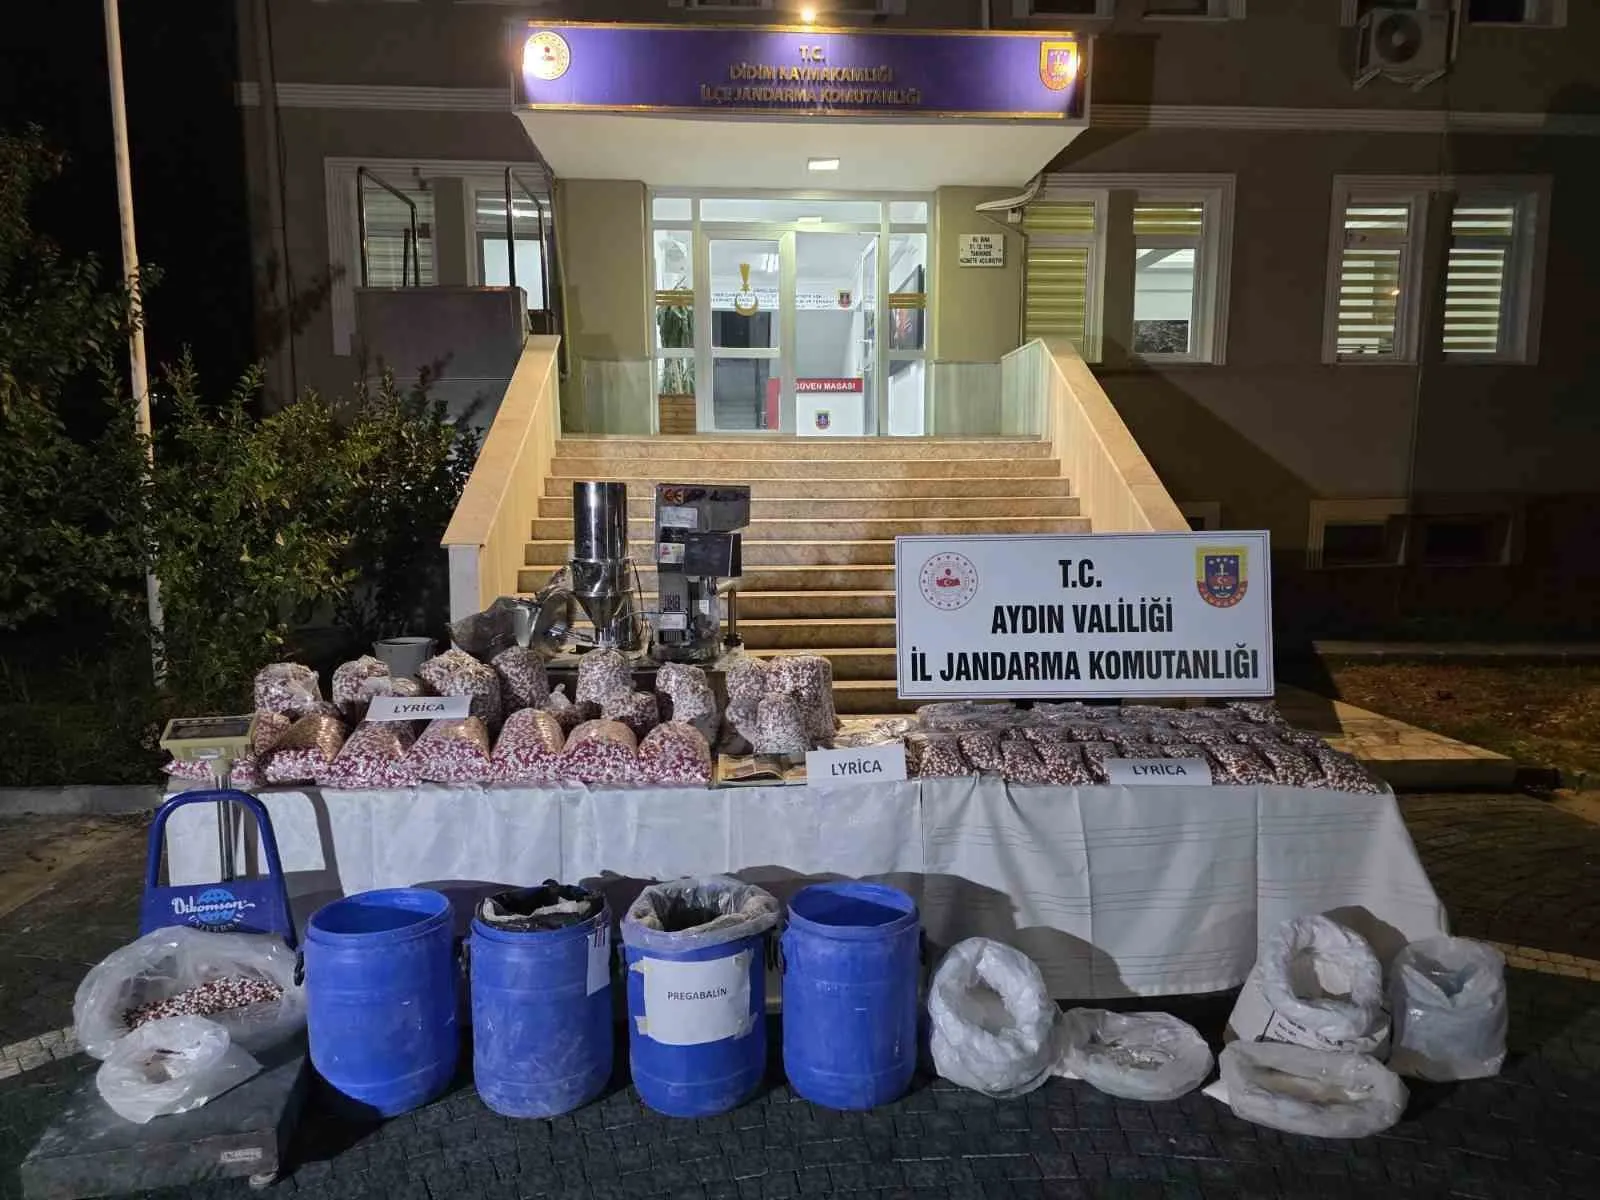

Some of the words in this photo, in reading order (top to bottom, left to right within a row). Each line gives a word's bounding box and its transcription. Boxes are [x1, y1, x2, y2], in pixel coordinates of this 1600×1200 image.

[800, 46, 826, 62] T.C.
[735, 87, 816, 102] JANDARMA
[820, 88, 921, 105] KOMUTANLIĞI
[824, 382, 856, 391] MASASI
[1059, 559, 1103, 588] T.C.
[991, 604, 1065, 634] AYDIN
[1072, 596, 1174, 633] VALİLİĞİ
[911, 646, 933, 682] İL
[940, 650, 1082, 682] JANDARMA
[1089, 641, 1259, 681] KOMUTANLIĞI
[393, 702, 445, 713] LYRİCA
[831, 758, 882, 776] LYRİCA
